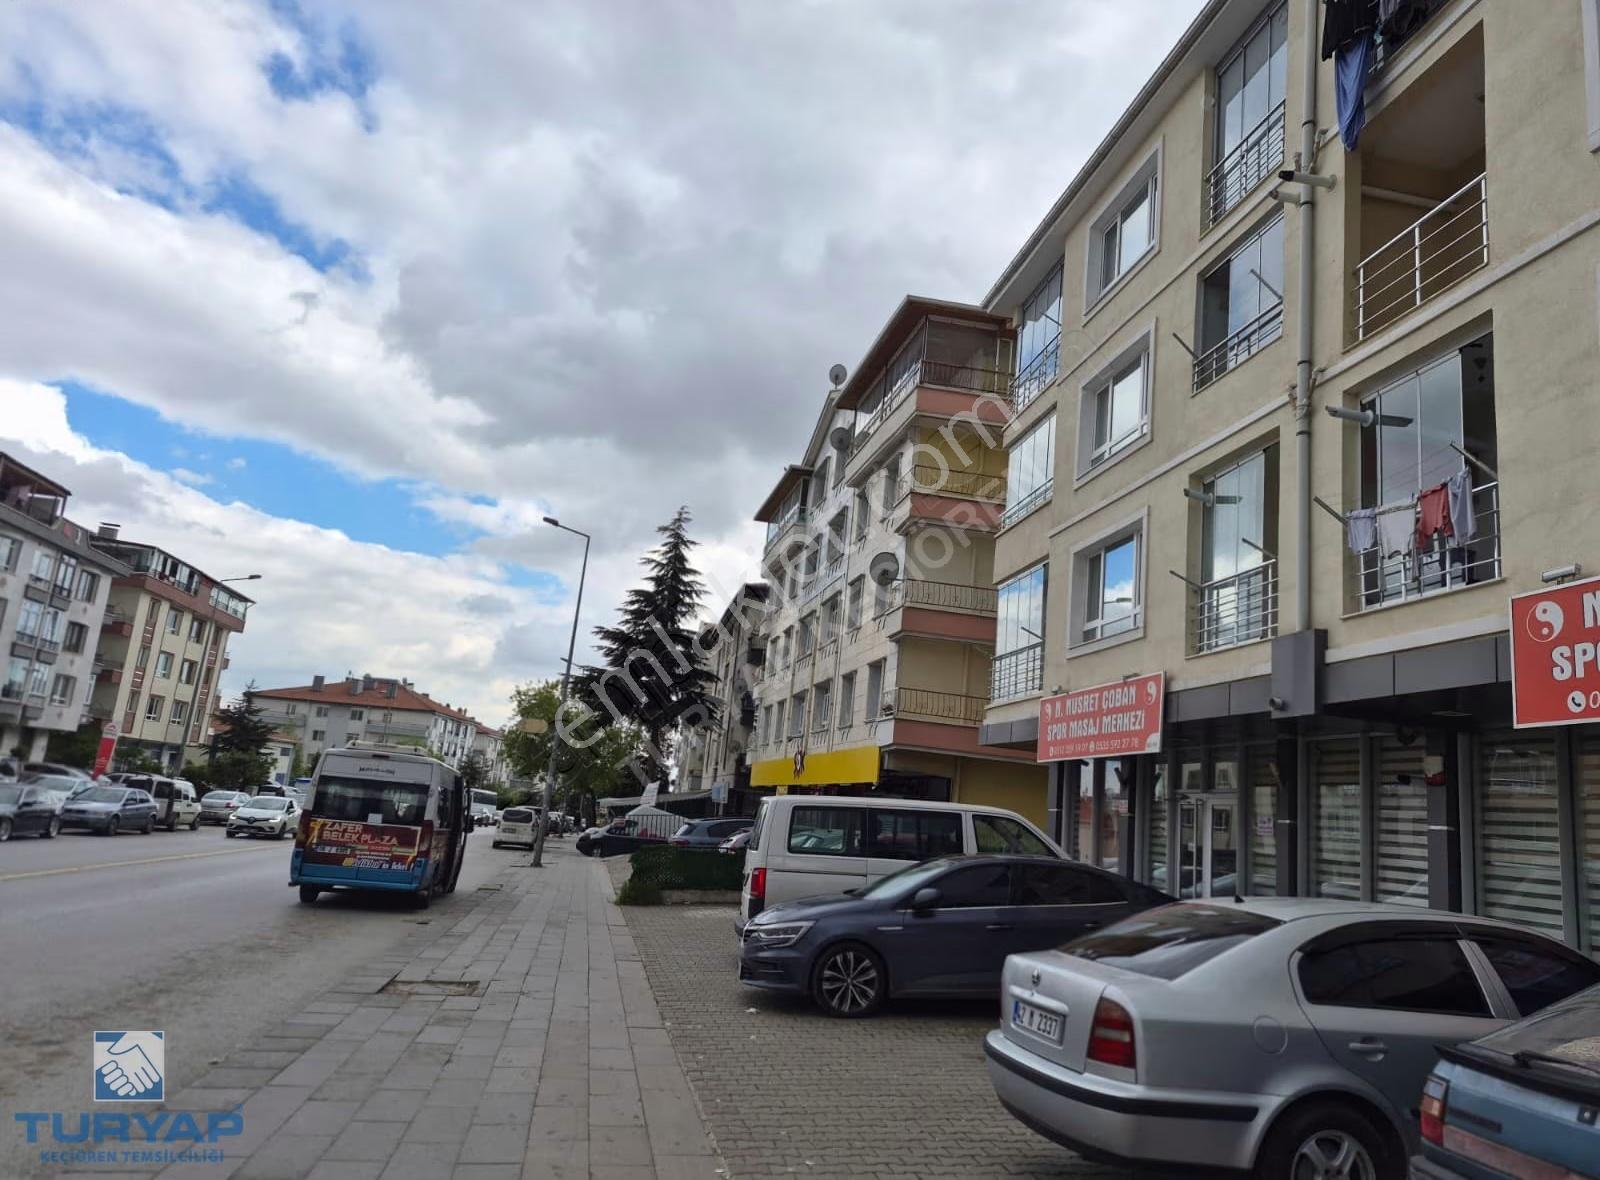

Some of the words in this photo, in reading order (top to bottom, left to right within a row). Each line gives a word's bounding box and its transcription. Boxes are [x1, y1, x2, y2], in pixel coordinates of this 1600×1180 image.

[1551, 642, 1600, 681] SP
[1066, 692, 1099, 716] NUSRET
[1102, 685, 1136, 712] ÇOBAN
[1047, 722, 1066, 741] SPOR
[1069, 717, 1099, 738] MASAJ
[322, 831, 360, 842] BELEK
[324, 821, 364, 833] ZAFER
